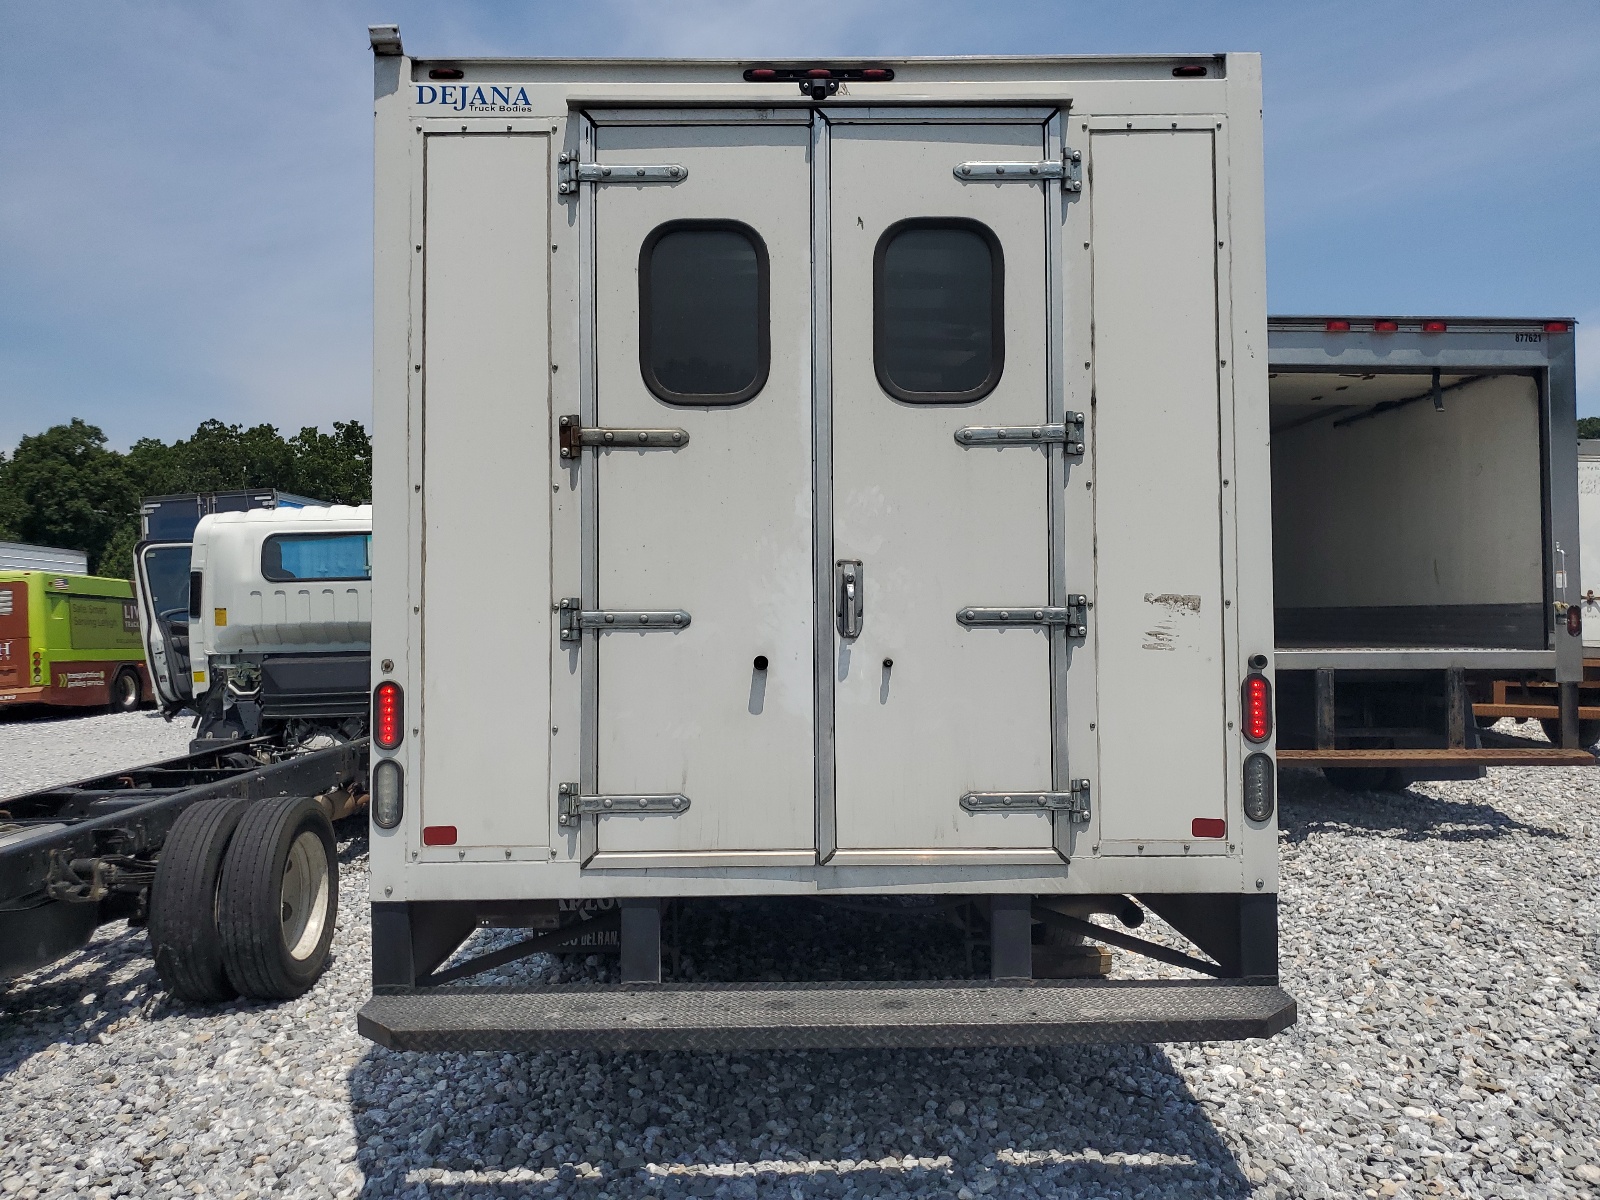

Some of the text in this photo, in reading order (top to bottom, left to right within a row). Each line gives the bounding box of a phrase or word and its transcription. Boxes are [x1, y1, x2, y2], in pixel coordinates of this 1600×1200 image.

[416, 85, 532, 111] DEJANA
[469, 104, 532, 113] Truck Bodies
[1515, 333, 1541, 342] 877621
